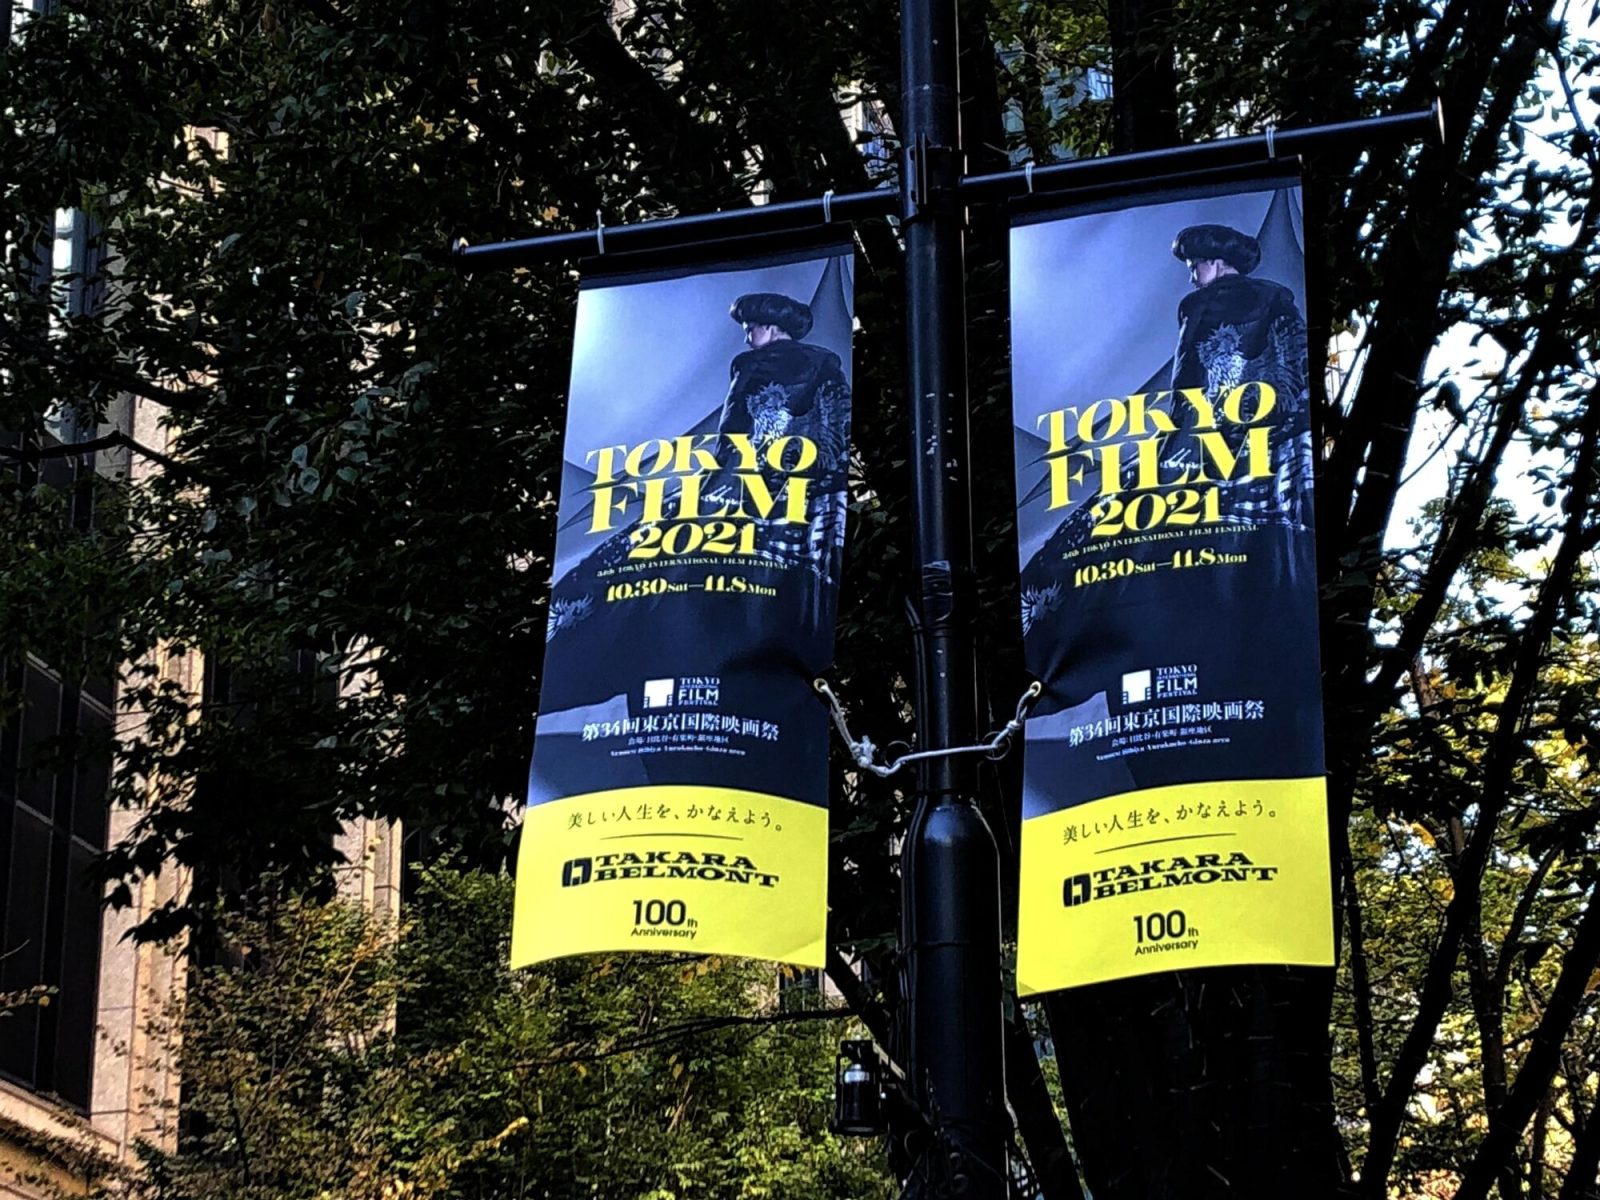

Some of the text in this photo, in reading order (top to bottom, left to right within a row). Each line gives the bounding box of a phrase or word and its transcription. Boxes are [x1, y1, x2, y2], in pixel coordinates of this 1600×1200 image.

[1036, 381, 1276, 454] TOKYO
[585, 433, 817, 486] TOKYO
[1044, 425, 1276, 512] FILM
[585, 473, 816, 534] FILM
[1090, 486, 1222, 538] 2021
[628, 521, 757, 559] 2021
[1082, 541, 1110, 554] TOKYO
[1112, 531, 1185, 548] INTERNATIONAL
[1188, 527, 1212, 537] FILM
[1215, 524, 1259, 534] FESTIVAL
[648, 557, 719, 569] INTERNATIONAL
[723, 557, 745, 566] FILM
[749, 559, 788, 570] FESTIVAL
[680, 676, 720, 685] TOKYO
[1156, 664, 1198, 676] TOKYO
[1156, 677, 1198, 693] FILM
[678, 688, 719, 701] FILM
[1156, 689, 1198, 699] FESTIVAL
[582, 712, 780, 742] 第34回東京国際映画祭
[1068, 700, 1265, 748] 第34回東京国際映画祭
[568, 803, 783, 832] 美しい人生を、かなえよう。
[1063, 799, 1277, 845] 美しい人生を、かなえよう。
[595, 851, 757, 870] TAKARA
[1093, 852, 1254, 884] TAKARA
[594, 866, 779, 888] BELMONT
[1093, 867, 1278, 900] BELMONT
[631, 927, 697, 939] Anniversary
[1134, 938, 1199, 956] Anniversary
